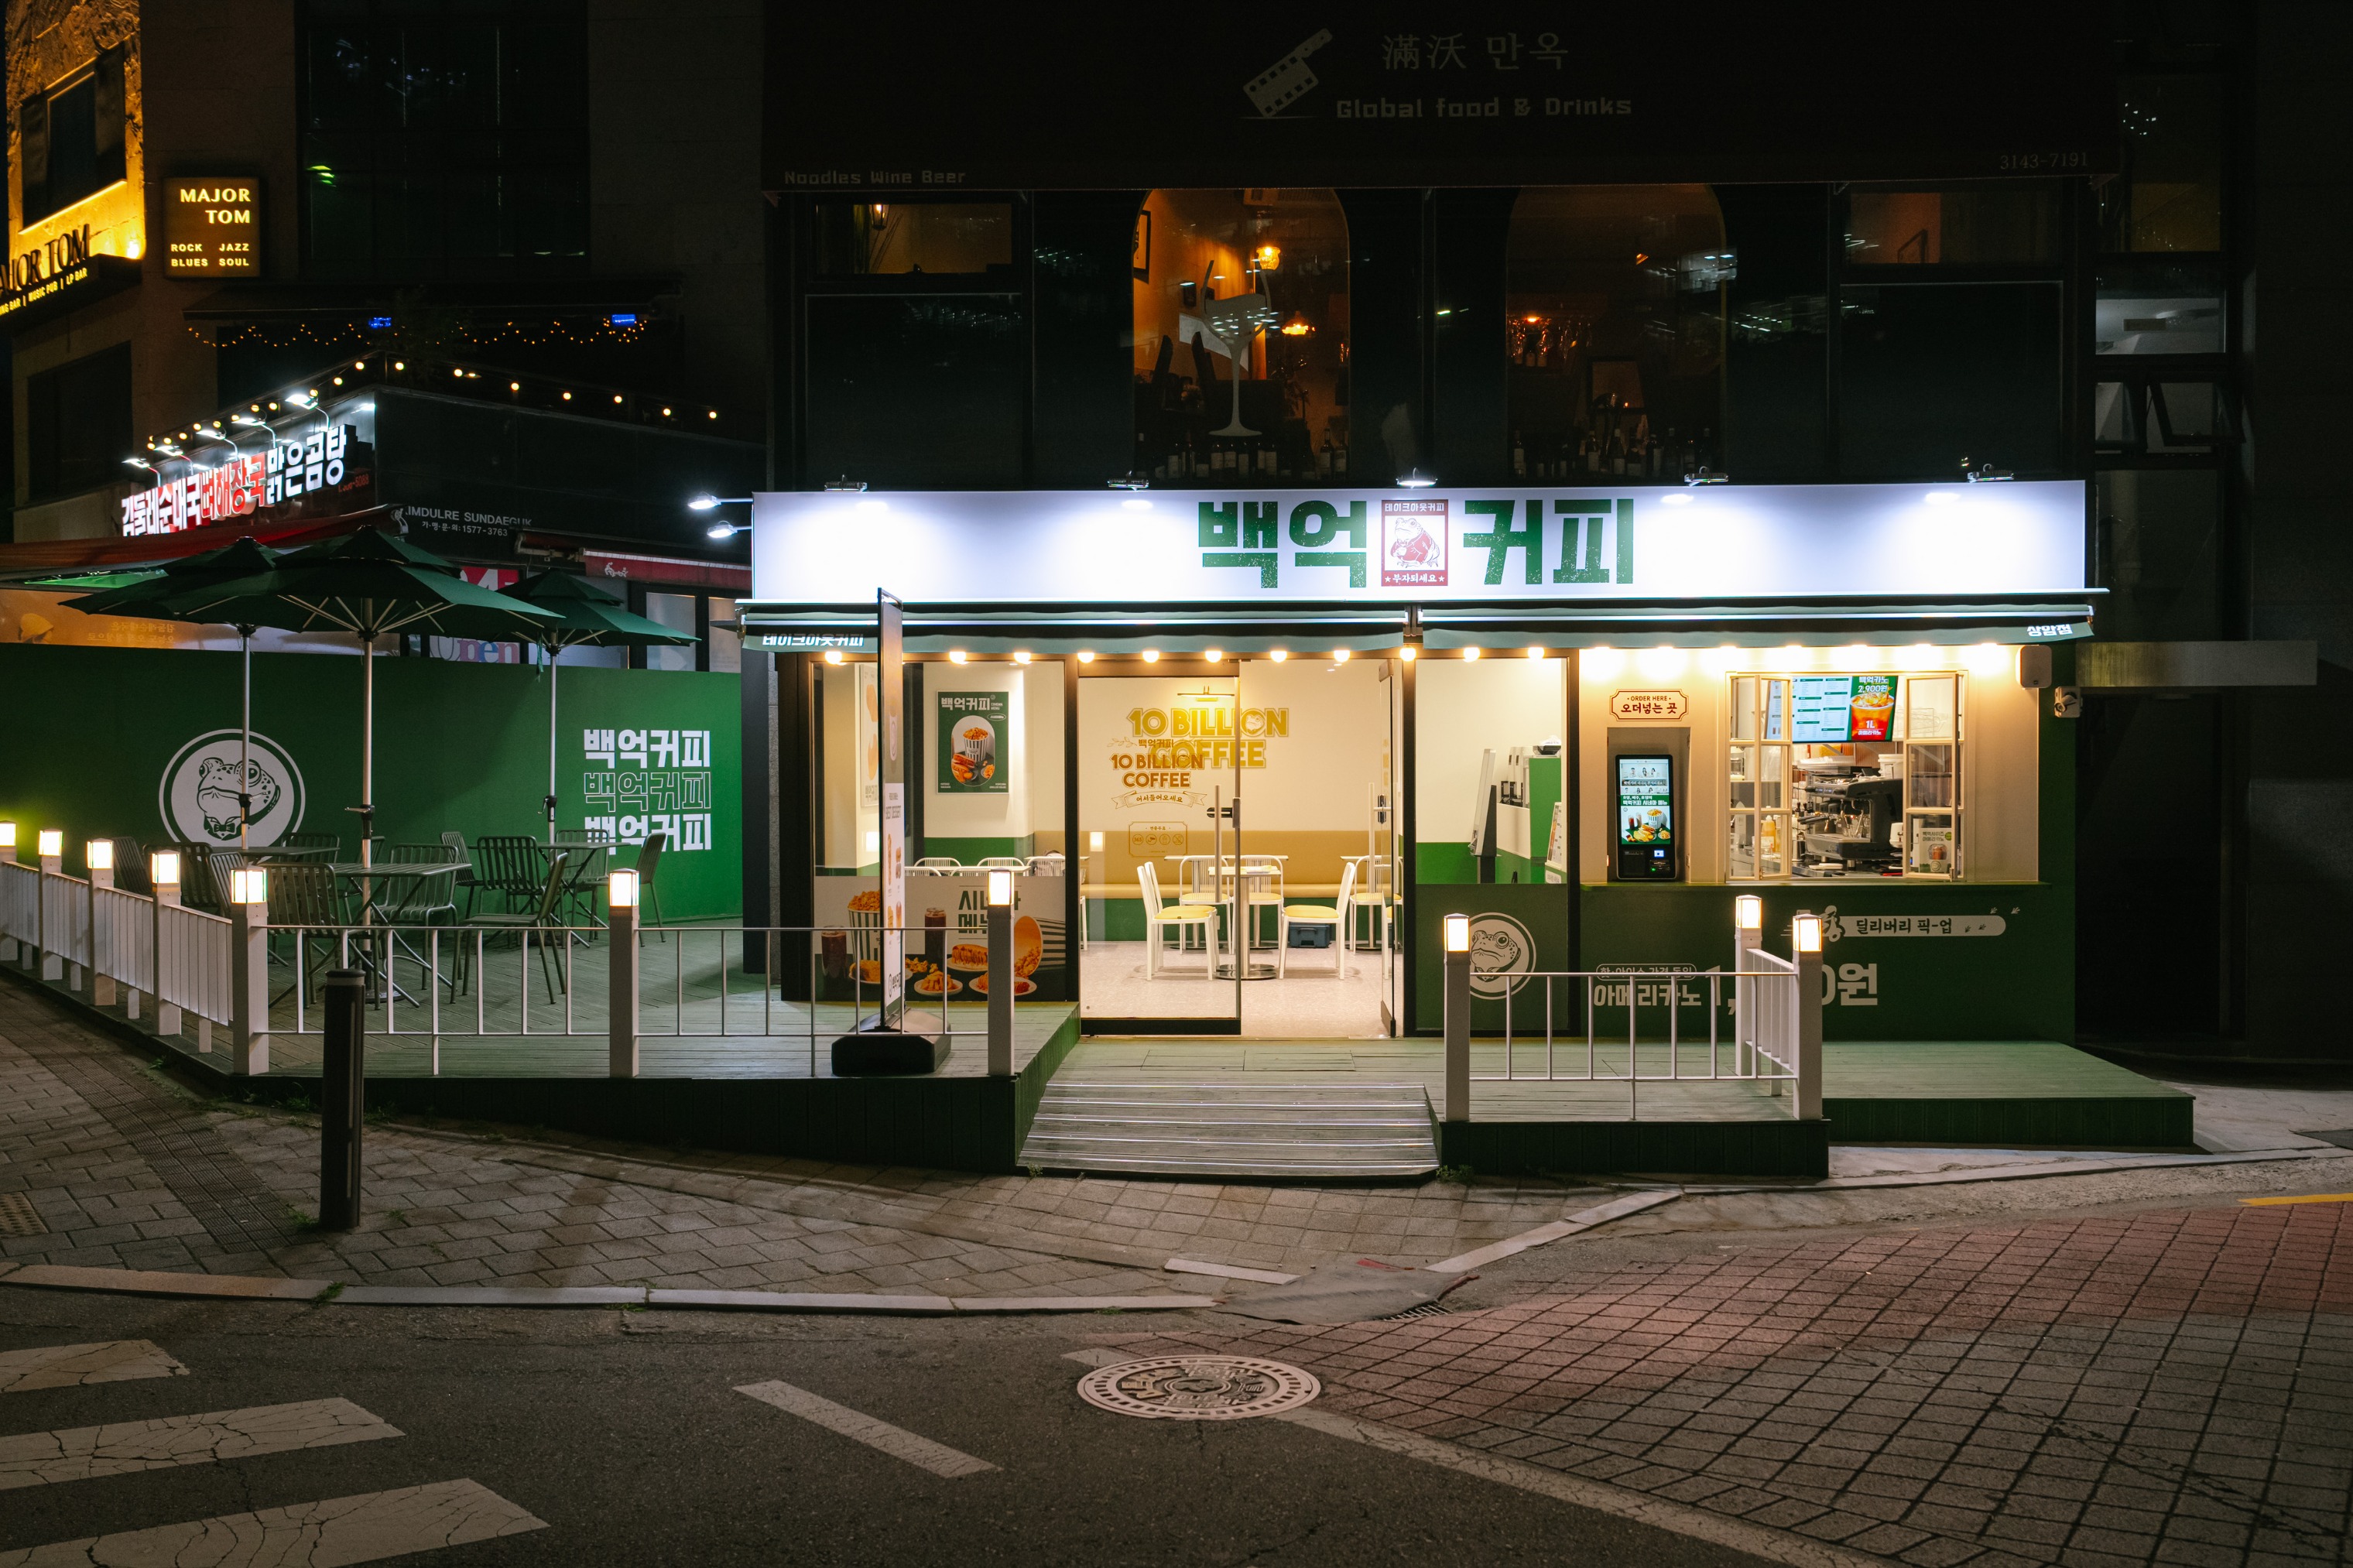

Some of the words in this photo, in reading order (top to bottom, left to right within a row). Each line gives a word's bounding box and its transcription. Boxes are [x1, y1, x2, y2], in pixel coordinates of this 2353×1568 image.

[1382, 33, 1467, 70] 滿沃
[1486, 33, 1569, 70] 만옥
[1337, 99, 1423, 118] Global
[1437, 98, 1499, 118] food
[1515, 98, 1531, 116] &
[1546, 97, 1632, 115] Drinks
[2000, 152, 2088, 169] 3143-7191
[785, 170, 861, 185] Noodles
[871, 170, 912, 184] Wine
[922, 169, 966, 184] Beer
[180, 188, 251, 203] MAJOR
[205, 210, 251, 224] TOM
[171, 243, 203, 252] ROCK
[219, 243, 249, 252] JAZZ
[0, 249, 42, 295] AJOR
[45, 224, 90, 275] TOM
[171, 258, 208, 267] BLUES
[67, 273, 74, 285] LP
[75, 267, 87, 281] BAR
[406, 505, 460, 520] IMDULRE
[1385, 502, 1445, 512] 테이크아웃커피
[1198, 500, 1367, 589] 백억
[1463, 498, 1634, 585] 커피
[1392, 573, 1437, 583] 부자되세요
[2026, 624, 2074, 637] 상암점
[762, 633, 865, 647] 테이크아웃커피
[1858, 685, 1888, 693] 2,900원
[940, 697, 990, 710] 백억커피
[1621, 703, 1663, 714] 오더넣는
[1666, 703, 1677, 714] 곳
[1127, 708, 1168, 737] 10
[1171, 708, 1289, 738] BILLON
[1866, 720, 1875, 729] 1L
[584, 729, 711, 769] 백억커피
[1139, 739, 1174, 748] 백억커피
[1110, 753, 1133, 770] 10
[1135, 753, 1204, 770] BILLION
[1149, 739, 1266, 769] COFFEE
[1122, 772, 1191, 788] COFFEE
[584, 772, 711, 812] 백억커피
[1856, 918, 1911, 935] 딜리버리
[1917, 918, 1952, 934] 픽-업
